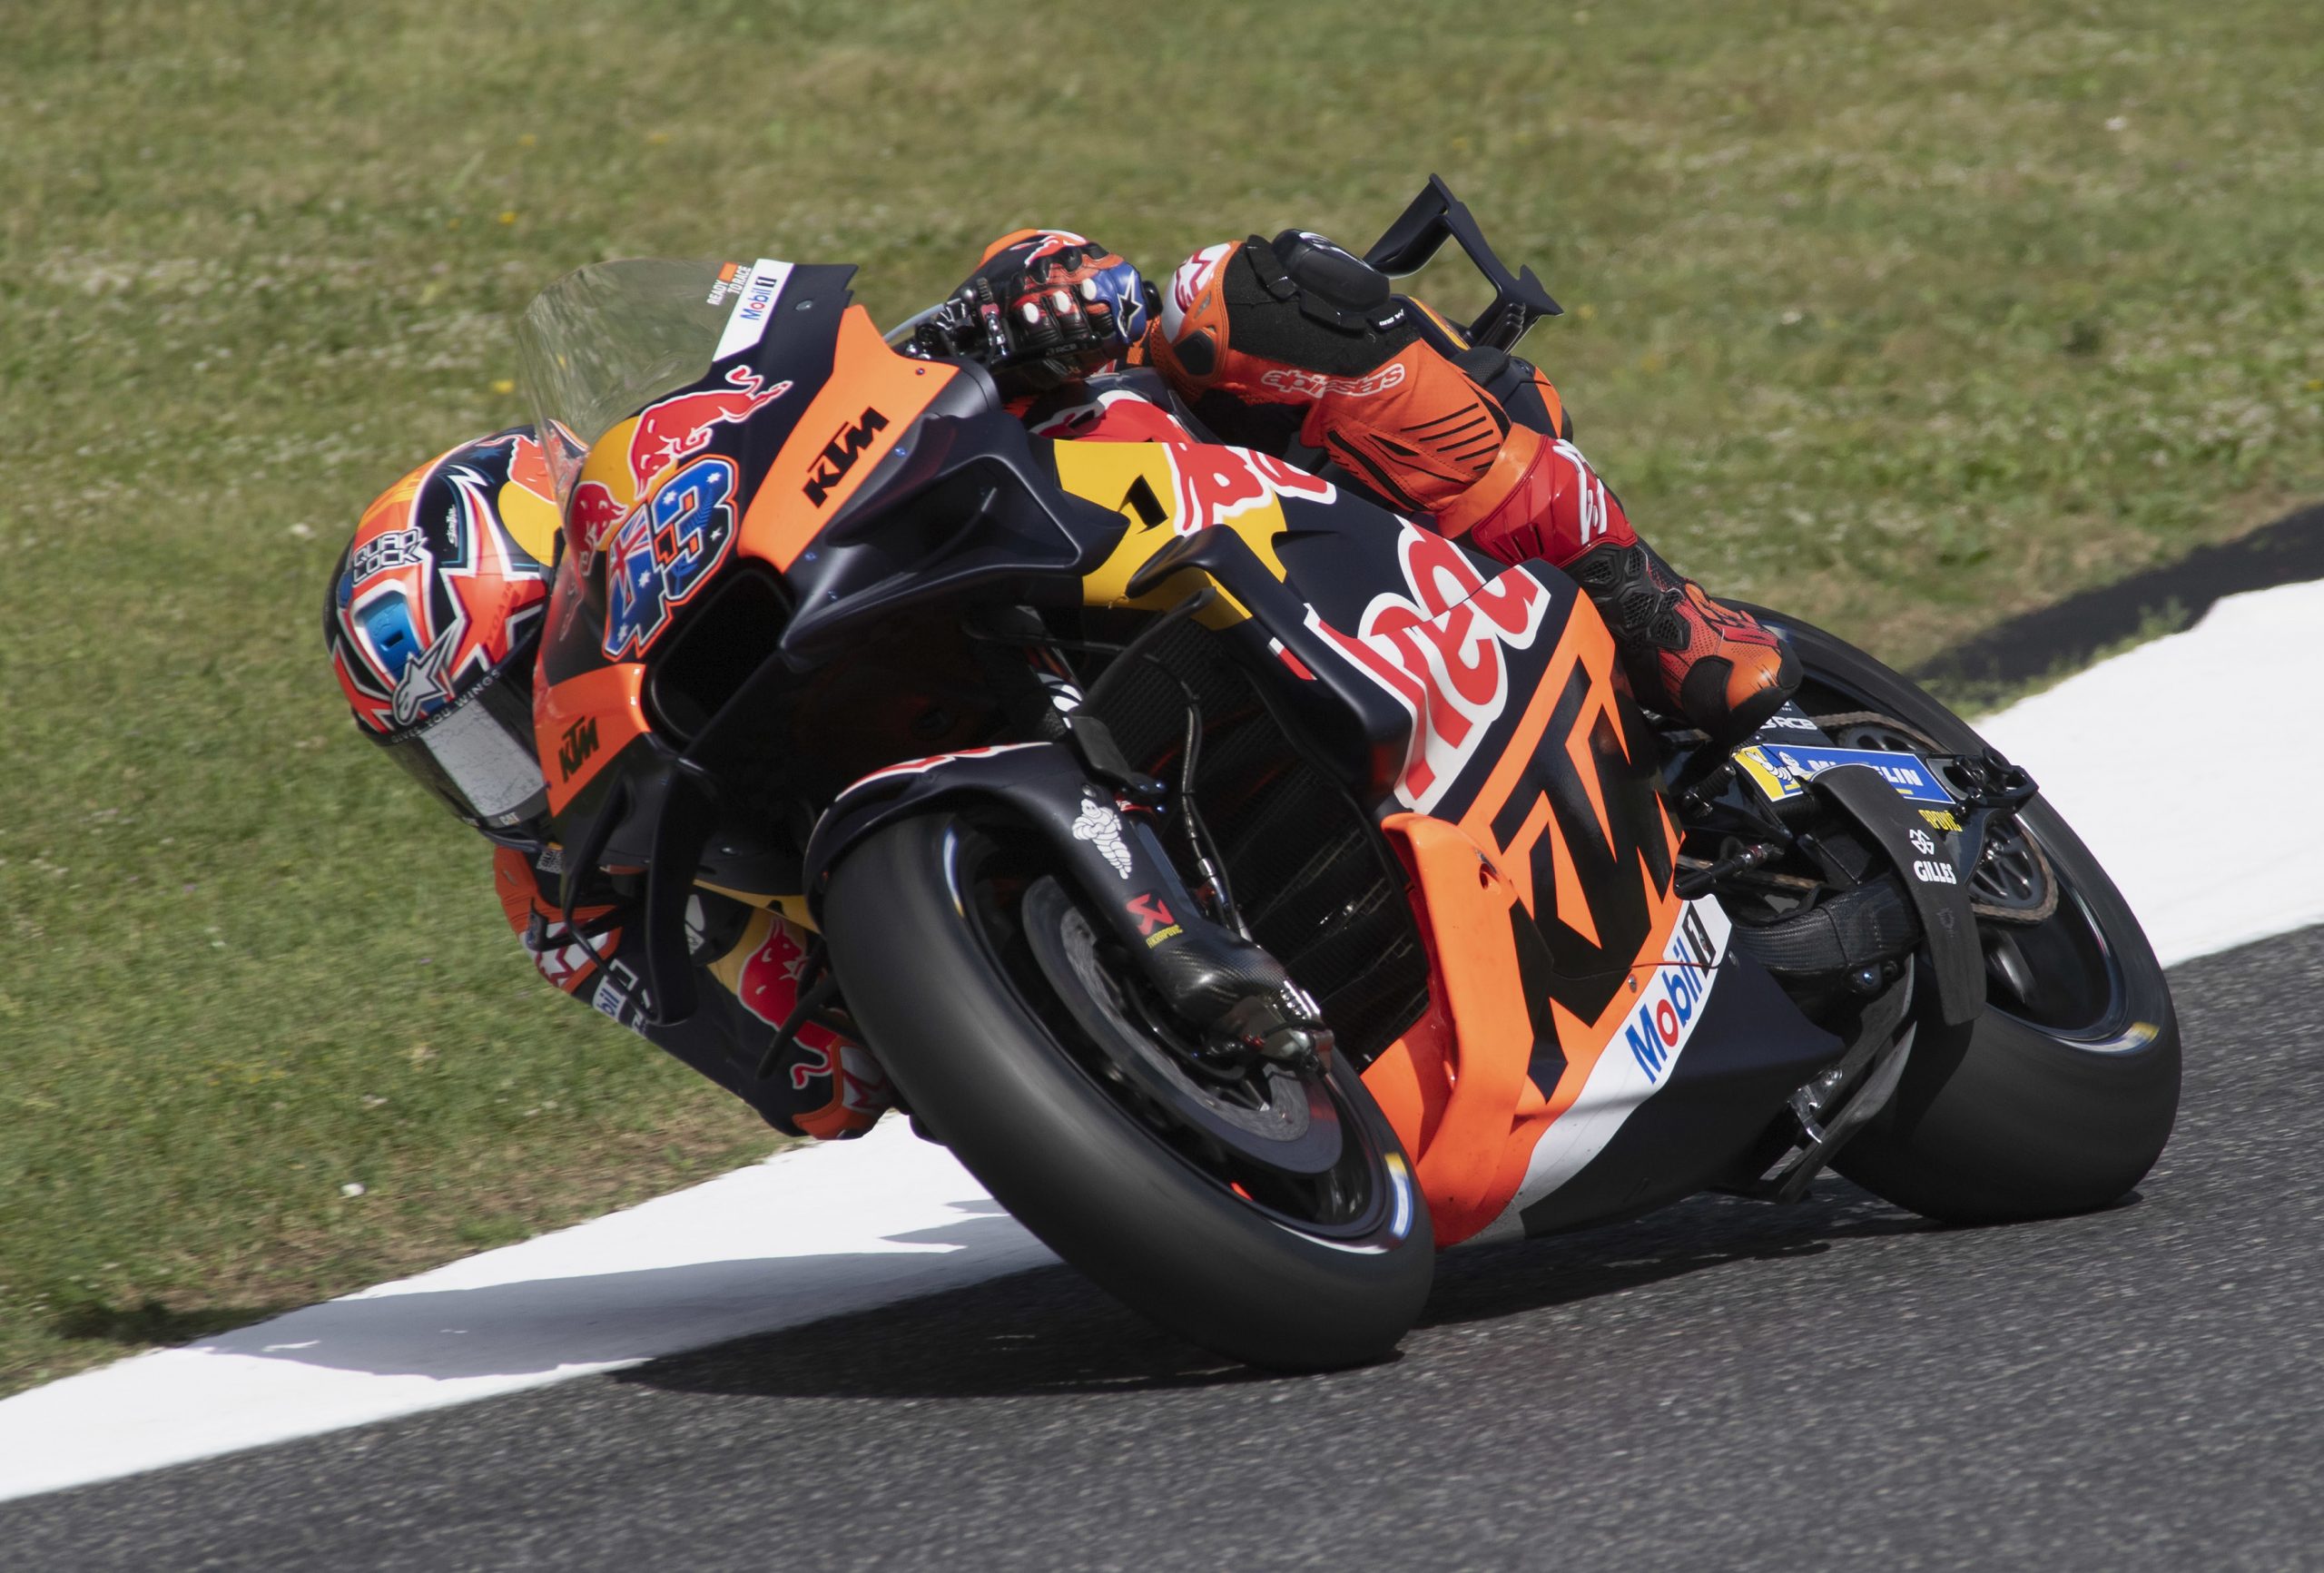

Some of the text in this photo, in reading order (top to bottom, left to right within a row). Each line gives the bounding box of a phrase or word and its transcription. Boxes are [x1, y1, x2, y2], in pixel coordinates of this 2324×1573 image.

[706, 279, 728, 306] READY
[727, 265, 752, 294] TO RACE
[740, 288, 772, 320] Mobil
[802, 406, 890, 509] KTM
[353, 527, 422, 569] QUAD
[353, 537, 428, 583] LOCK
[602, 454, 740, 662] 43
[1304, 514, 1551, 817] Red
[425, 709, 451, 727] YOU
[455, 668, 501, 708] WINGS
[1772, 715, 1817, 730] RCB
[558, 715, 599, 783] KTM
[1489, 654, 1685, 1105] KTM
[1914, 860, 1956, 884] GILLES
[1625, 910, 1713, 1085] Mobil 1
